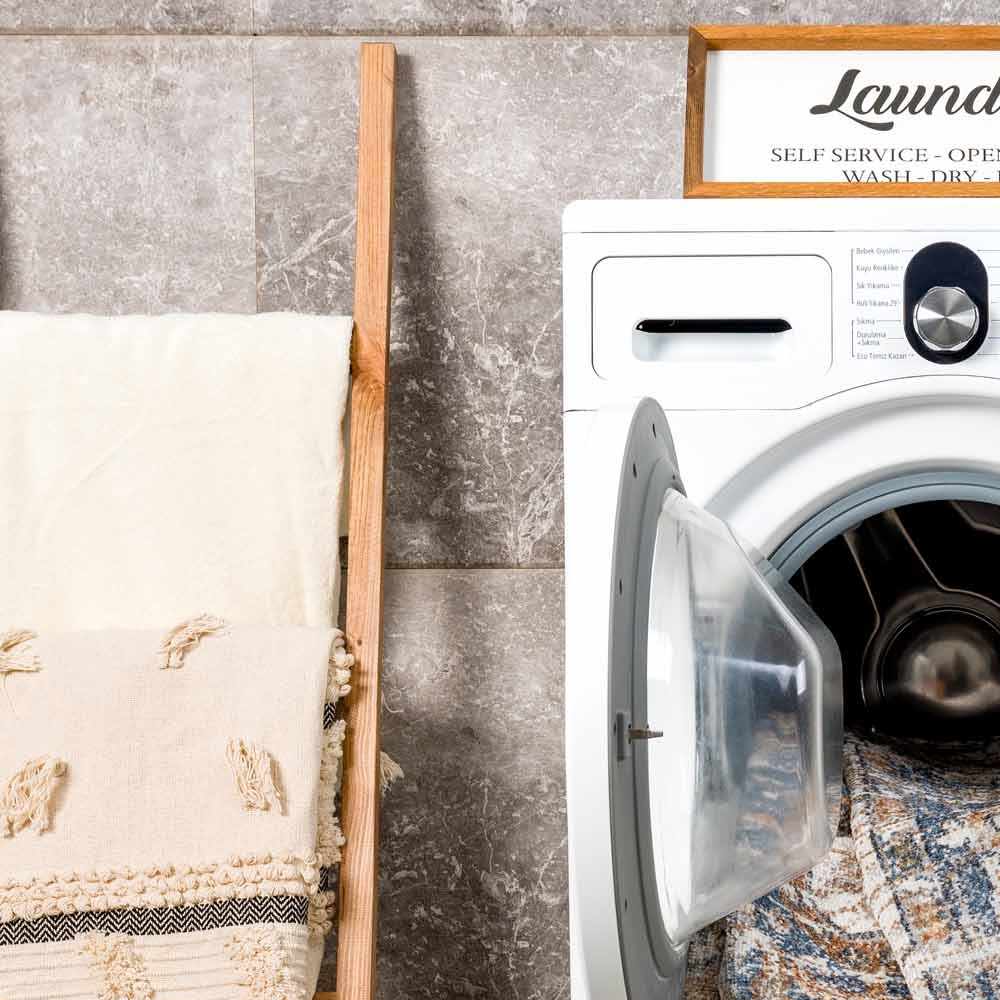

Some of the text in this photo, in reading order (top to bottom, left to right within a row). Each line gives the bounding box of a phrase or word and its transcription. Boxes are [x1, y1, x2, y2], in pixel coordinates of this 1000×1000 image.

[770, 147, 825, 162] SELF
[831, 147, 929, 163] SERVICE
[842, 169, 911, 182] WASH
[931, 169, 977, 182] DRY
